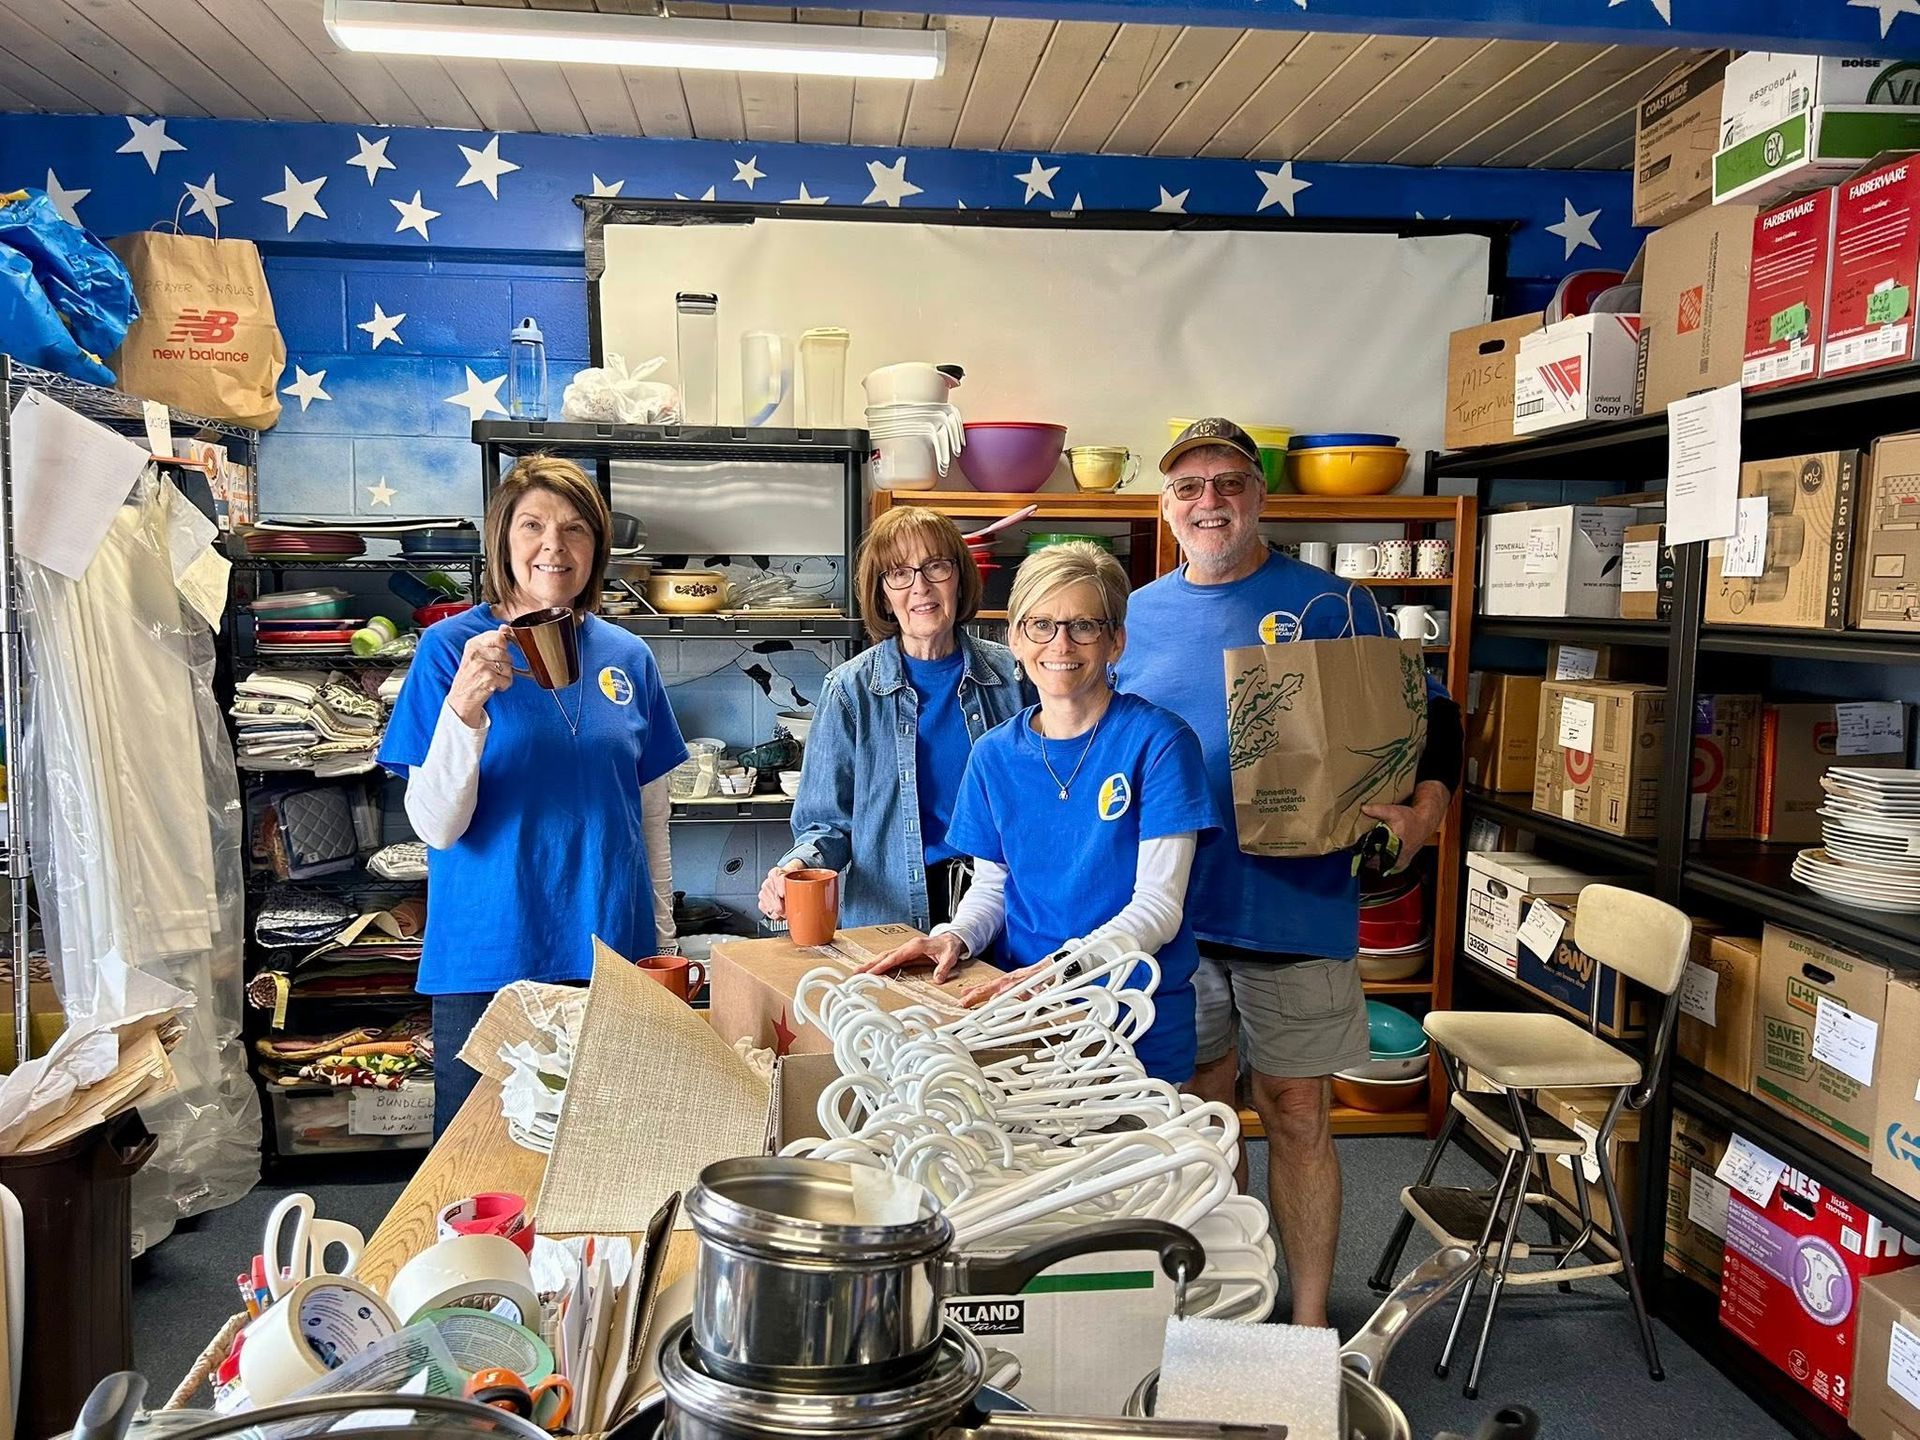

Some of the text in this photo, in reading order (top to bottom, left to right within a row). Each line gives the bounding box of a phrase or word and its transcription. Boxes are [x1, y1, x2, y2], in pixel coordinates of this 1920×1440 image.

[1645, 80, 1689, 118] COASTWIDE
[1849, 165, 1909, 200] FARBERWARE
[1763, 199, 1816, 230] FARBERWARE
[153, 348, 249, 362] new balance
[1635, 334, 1649, 409] MEDIUM
[1452, 400, 1494, 426] Tupper
[1594, 404, 1620, 415] Copy
[1804, 472, 1813, 483] 3
[1811, 466, 1821, 485] PC
[1831, 462, 1851, 617] 3PC STOCK POT SET
[1251, 795, 1305, 805] food standards
[1256, 787, 1297, 796] Pioneering
[1469, 937, 1488, 954] 33250
[1557, 943, 1594, 982] ewy
[1767, 1022, 1804, 1047] SAVE!
[377, 1095, 434, 1108] BUNDLED
[1779, 1164, 1820, 1203] GIES
[1825, 1203, 1854, 1223] movers
[1831, 1195, 1849, 1212] little
[945, 1304, 1019, 1322] KLAND
[1833, 1375, 1845, 1397] 3
